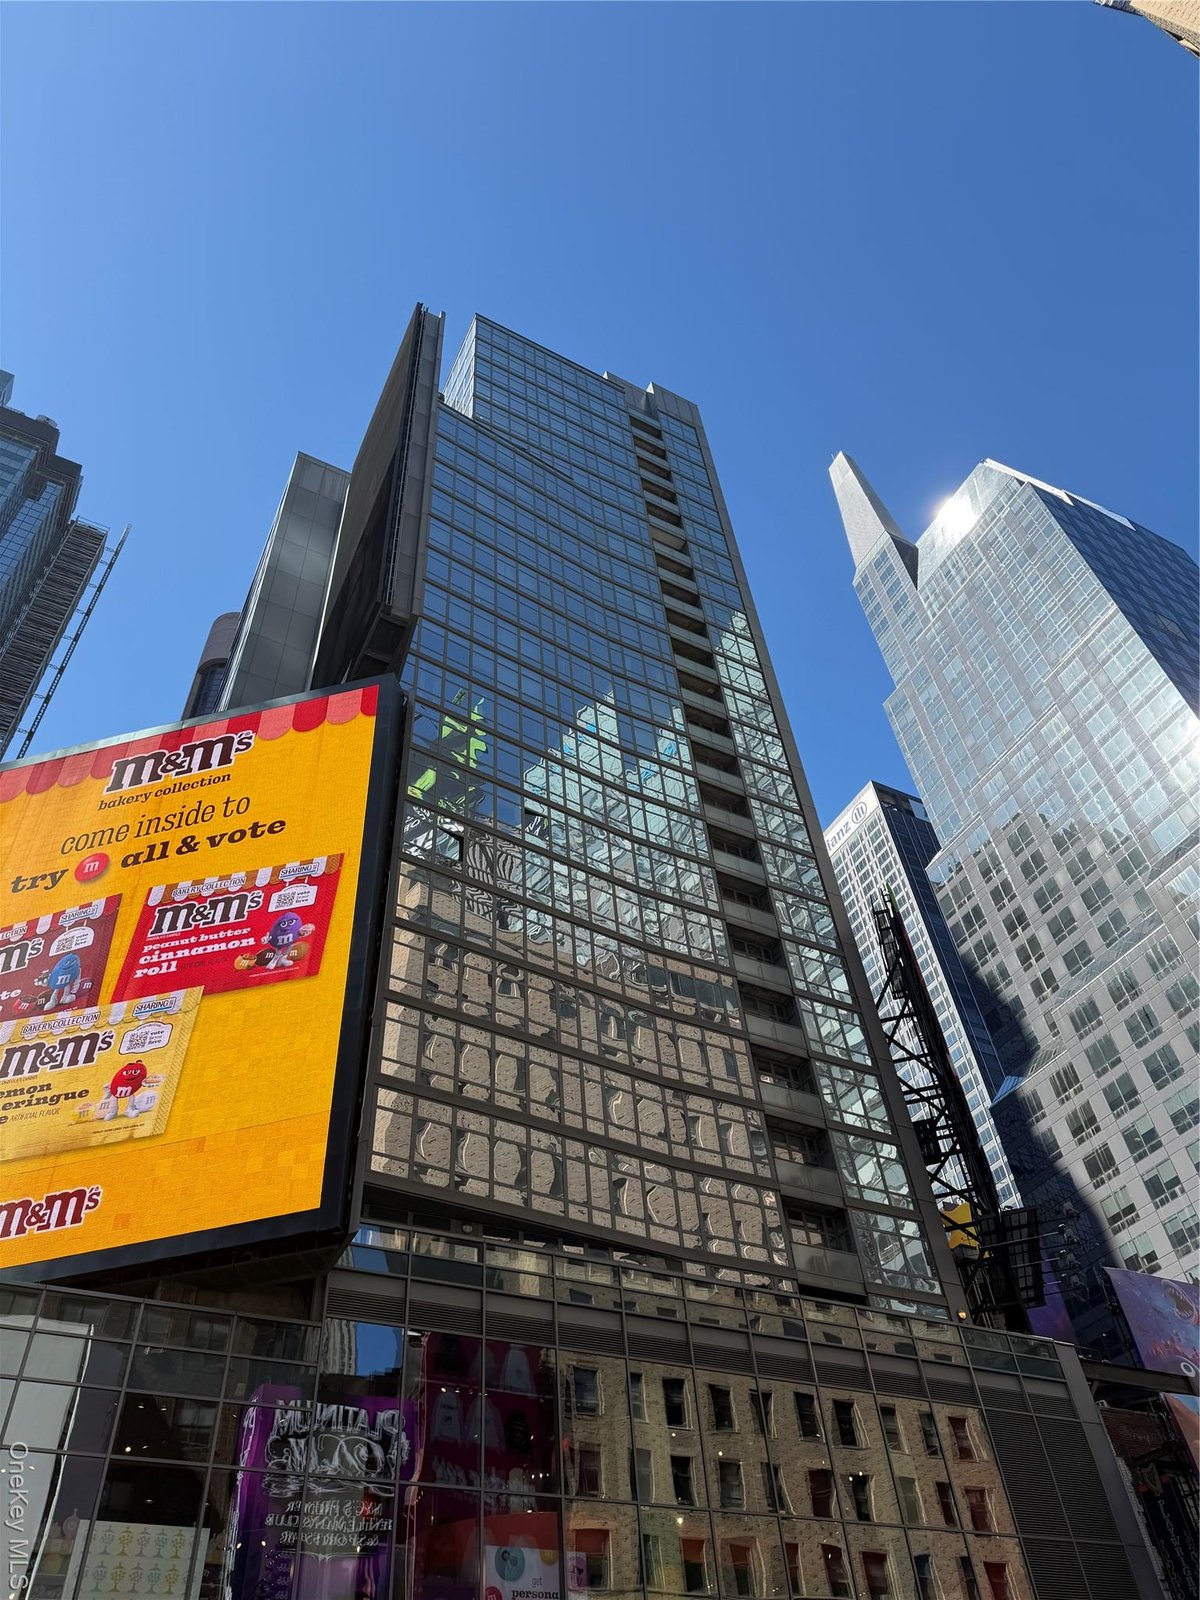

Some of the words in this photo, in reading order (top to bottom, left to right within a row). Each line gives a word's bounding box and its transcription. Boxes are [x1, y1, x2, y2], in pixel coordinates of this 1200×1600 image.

[97, 792, 152, 811] bakery
[154, 773, 231, 798] collection
[61, 824, 129, 855] come
[134, 801, 215, 839] inside
[222, 796, 250, 818] to
[11, 868, 69, 893] try
[120, 844, 170, 869] all
[175, 835, 200, 855] &
[206, 820, 287, 845] vote
[172, 886, 200, 897] BAKERY
[200, 877, 245, 892] COLLECTION
[138, 937, 256, 964] cinnamon
[142, 937, 197, 953] peanut
[198, 927, 251, 942] butter
[133, 960, 178, 978] roll
[135, 1001, 169, 1012] SHARING
[22, 1023, 52, 1034] BAKERY
[52, 1013, 99, 1028] COLLECTION
